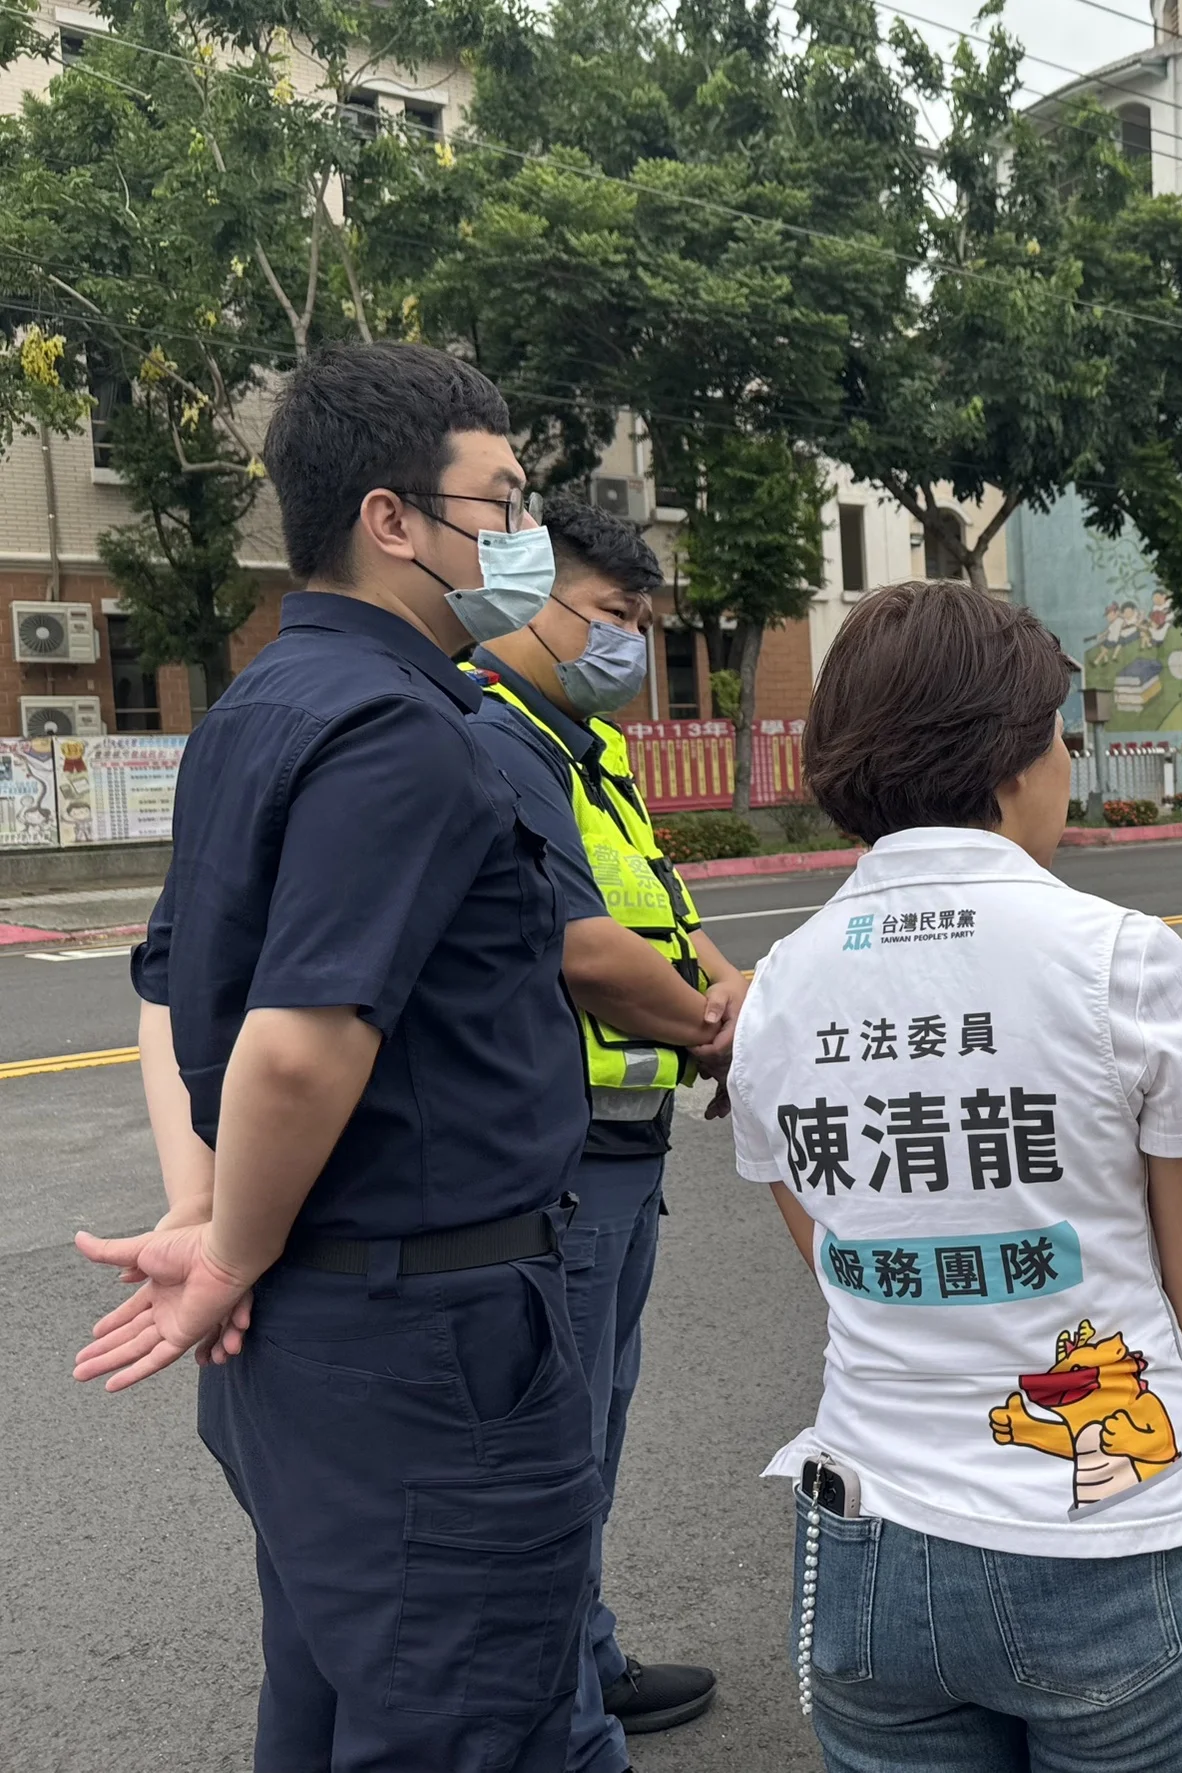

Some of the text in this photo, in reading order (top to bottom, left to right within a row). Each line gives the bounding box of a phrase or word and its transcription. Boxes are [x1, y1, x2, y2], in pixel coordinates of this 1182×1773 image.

[592, 843, 663, 890] 警察
[607, 890, 667, 909] OLICE
[882, 909, 976, 934] 台灣民眾黨
[881, 930, 975, 944] TAIWAN PEOPLE'S PARTY
[814, 1012, 998, 1065] 立法委員
[777, 1086, 1064, 1196] 陳清龍
[828, 1235, 1059, 1299] 服務團隊
